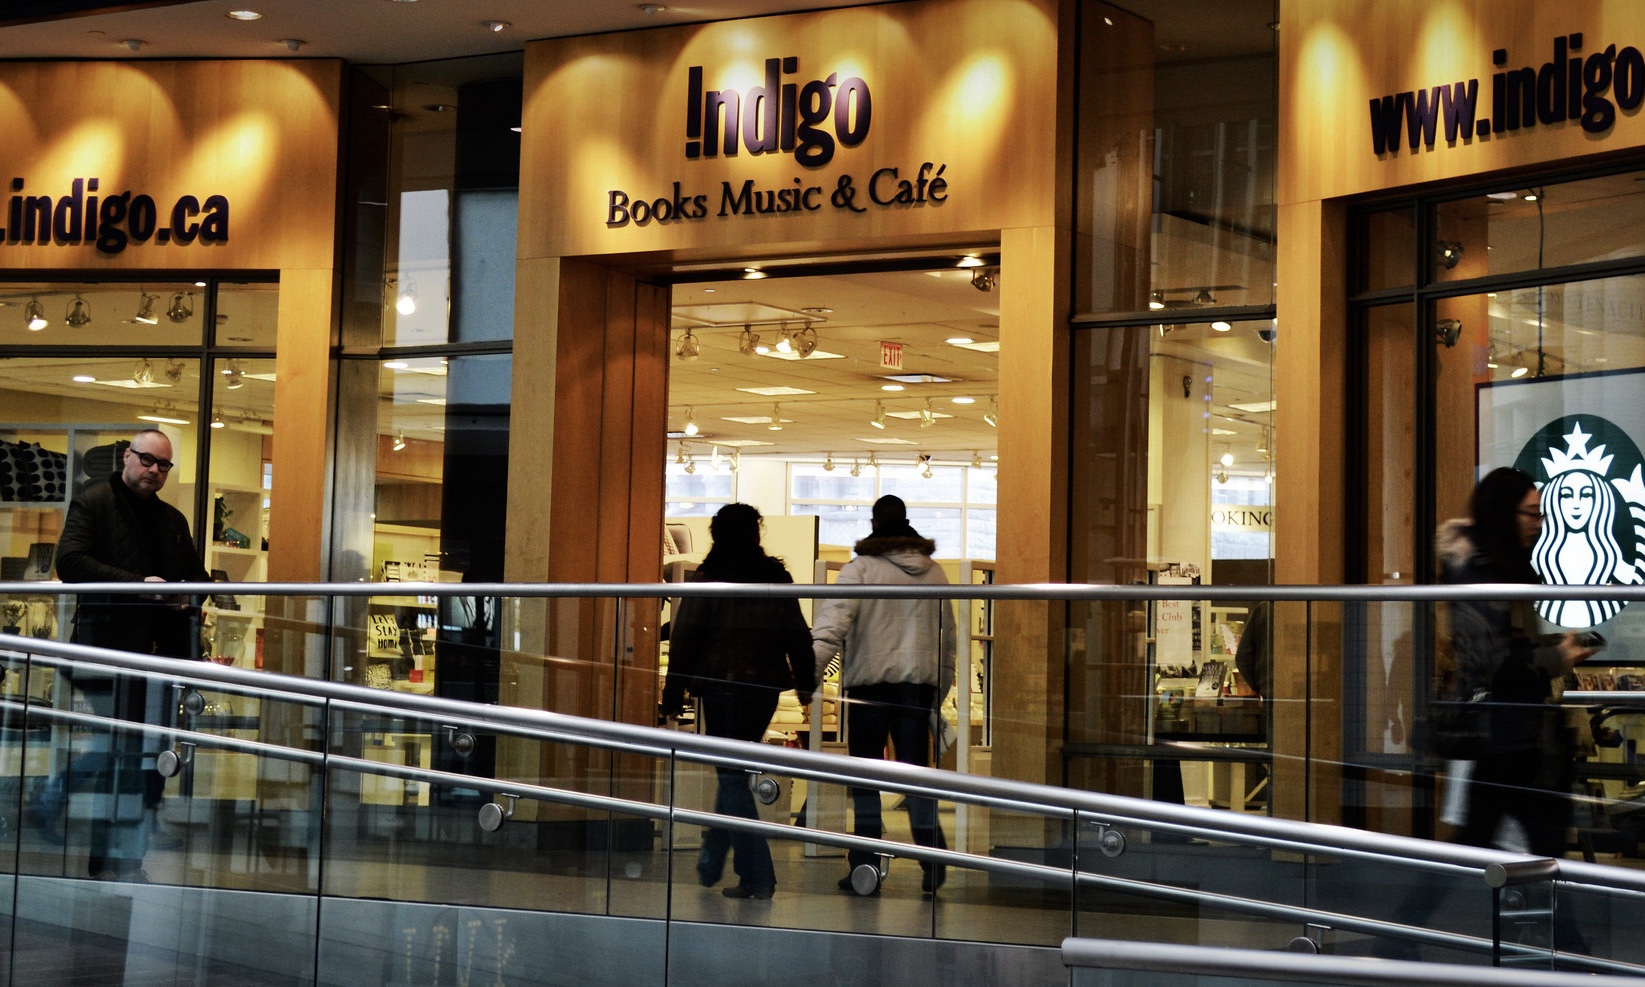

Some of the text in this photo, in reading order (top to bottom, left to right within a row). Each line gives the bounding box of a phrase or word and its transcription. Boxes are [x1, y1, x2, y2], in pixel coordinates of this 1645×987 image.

[1369, 33, 1645, 155] www.indigo
[606, 162, 949, 226] Books Music & Café
[883, 342, 901, 367] EXIT
[1161, 612, 1182, 621] Club
